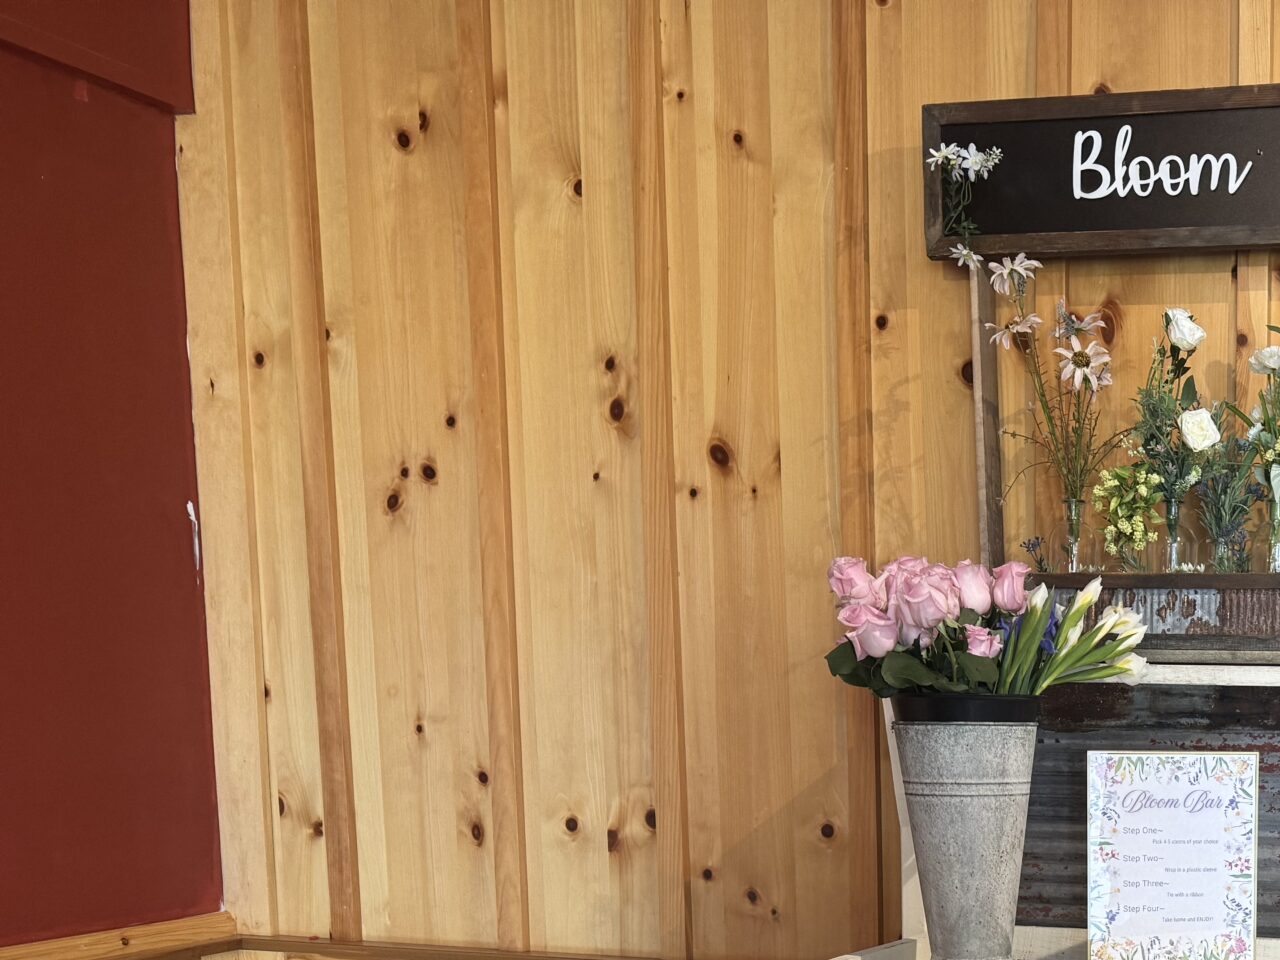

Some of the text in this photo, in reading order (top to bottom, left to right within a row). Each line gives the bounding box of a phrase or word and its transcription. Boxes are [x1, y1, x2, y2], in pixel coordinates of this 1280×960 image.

[1072, 124, 1254, 200] Bloom
[1121, 789, 1224, 814] Bloom Bar
[1122, 826, 1141, 836] Step
[1122, 854, 1141, 863] Step
[1122, 879, 1141, 888] Step
[1123, 904, 1141, 914] Step
